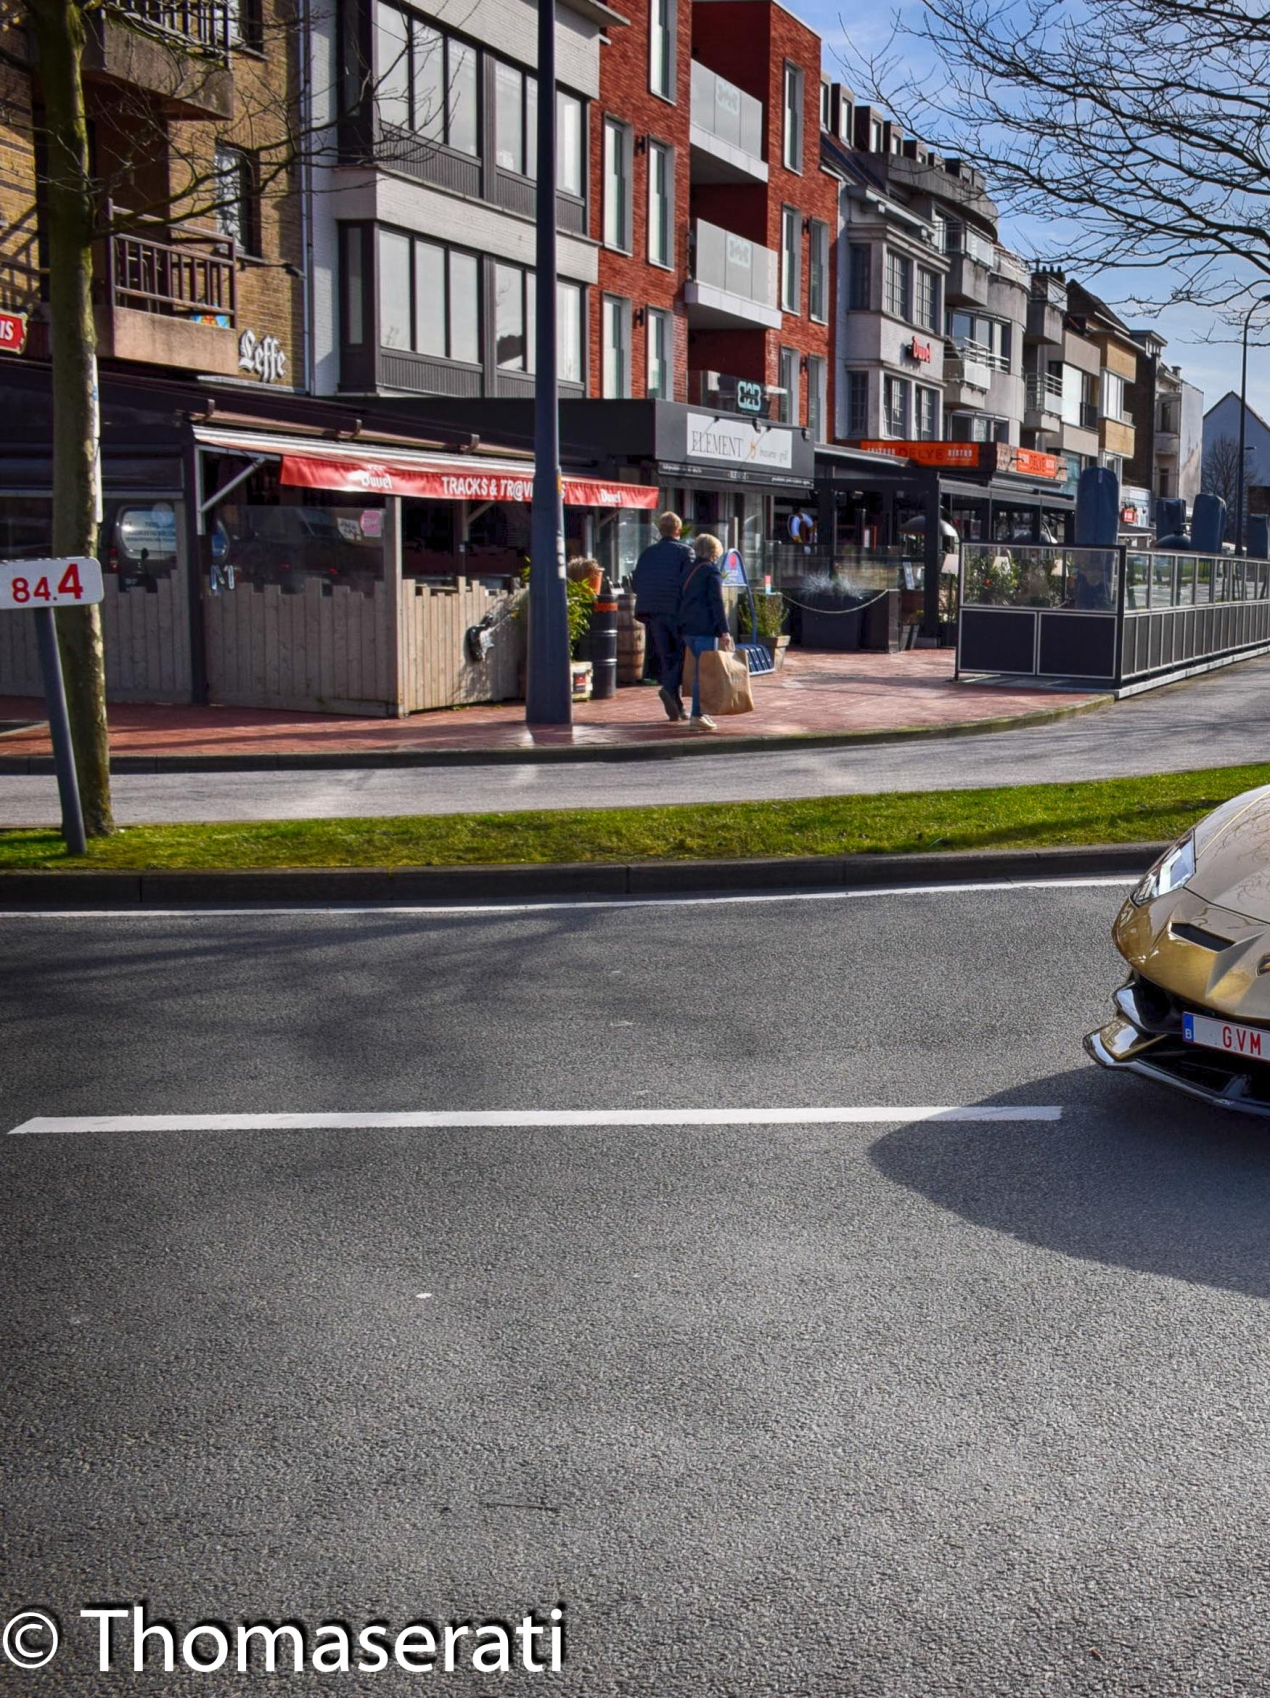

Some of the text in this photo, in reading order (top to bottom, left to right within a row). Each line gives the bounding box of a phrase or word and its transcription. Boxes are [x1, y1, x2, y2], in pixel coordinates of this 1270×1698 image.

[239, 329, 287, 383] Leffe
[912, 336, 932, 364] Duvel
[691, 431, 744, 458] ELEMENT
[441, 476, 487, 495] TRACKS
[489, 478, 498, 495] &
[11, 563, 84, 603] 84.4
[1185, 1028, 1193, 1039] B
[1222, 1026, 1261, 1056] GVM
